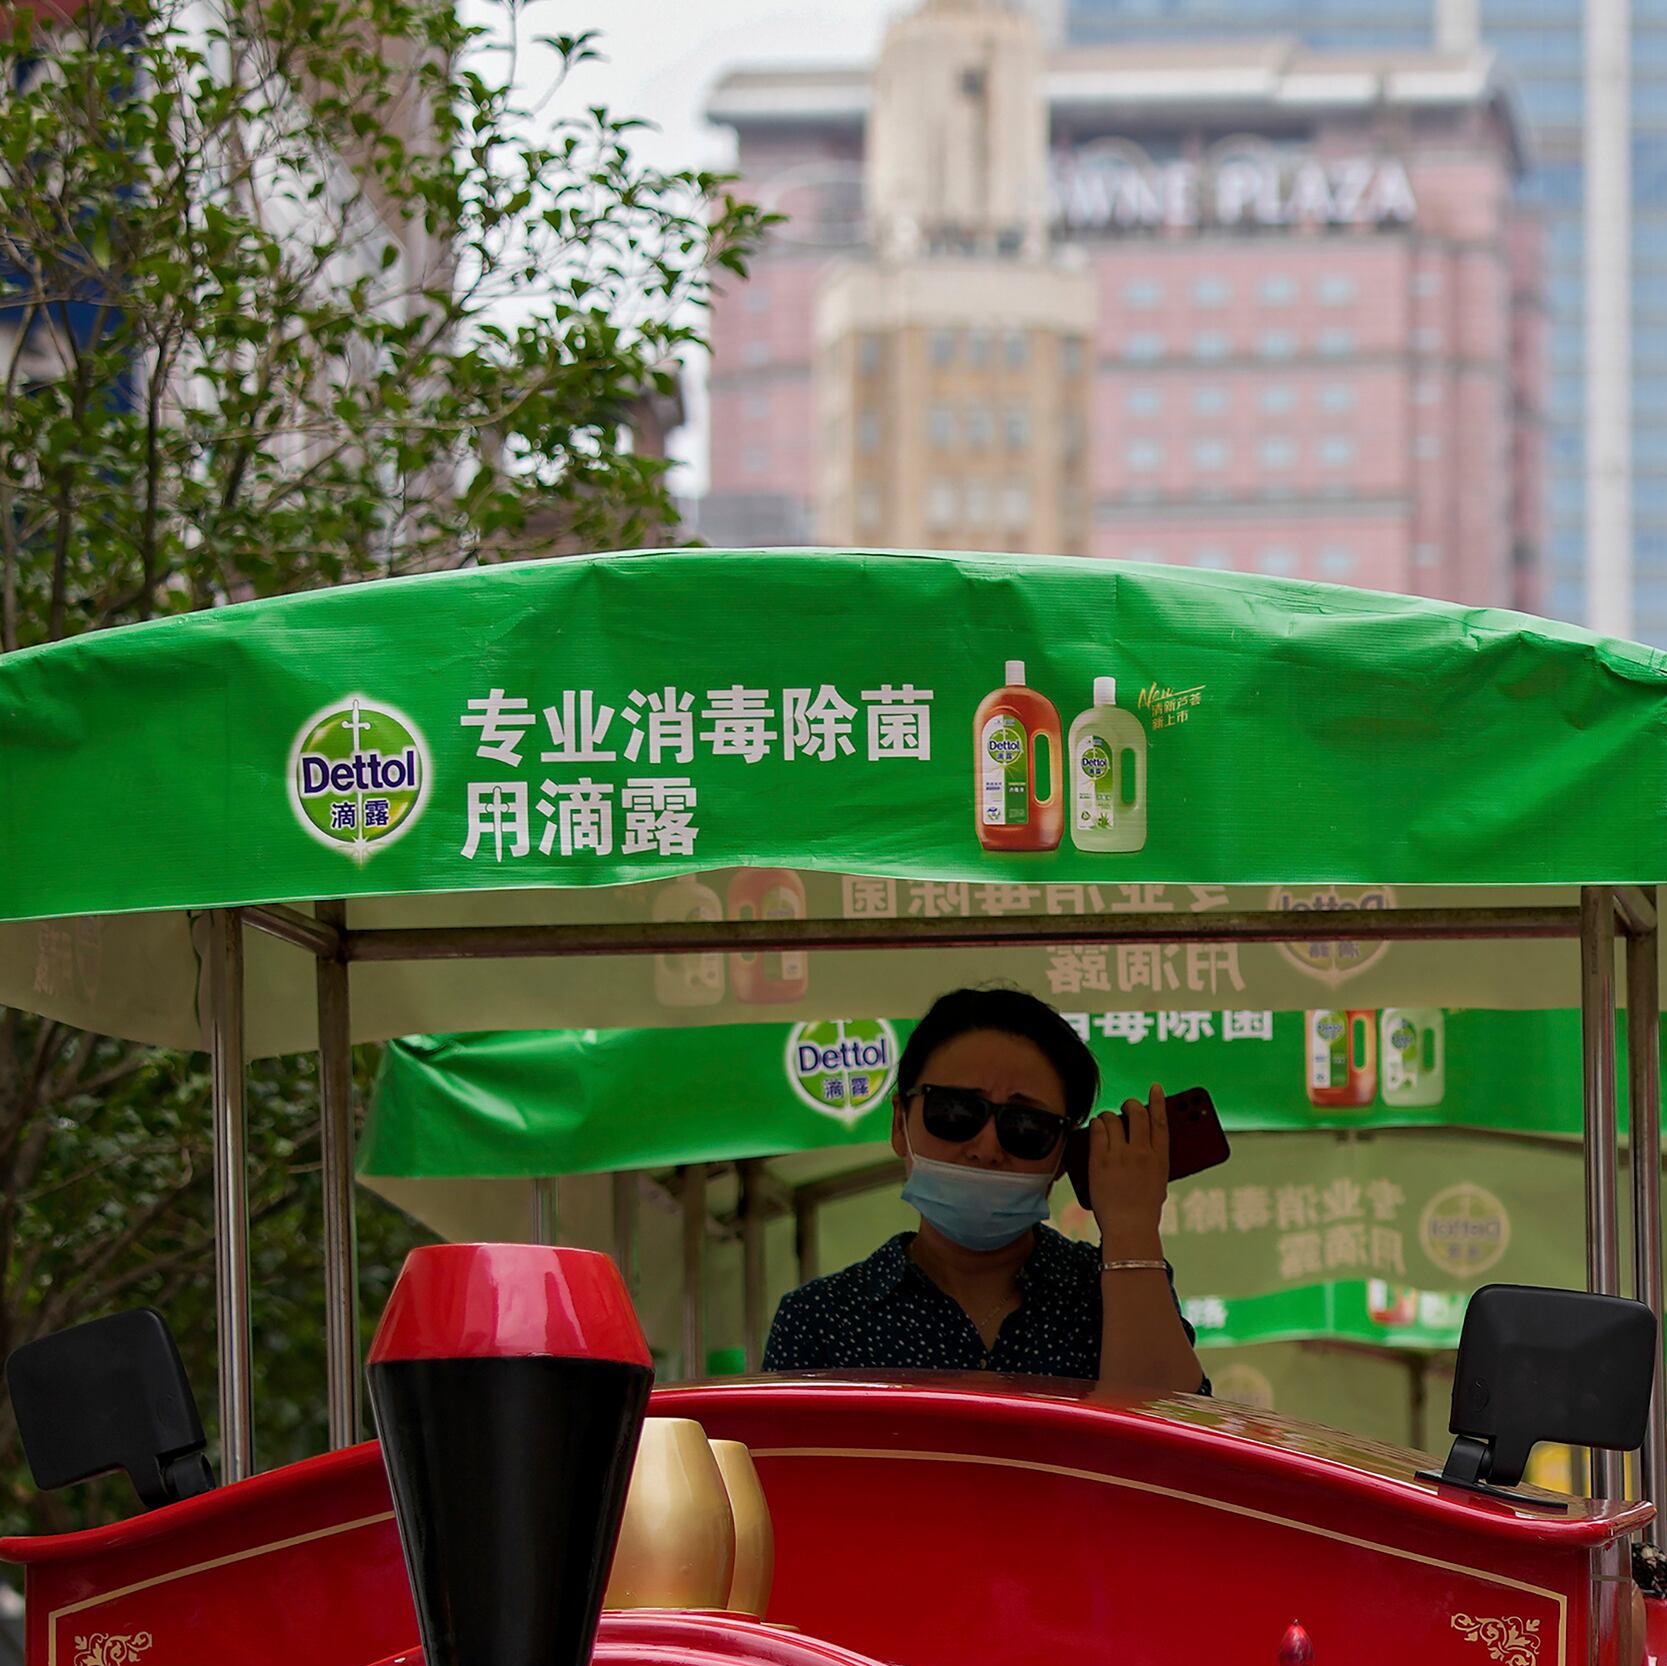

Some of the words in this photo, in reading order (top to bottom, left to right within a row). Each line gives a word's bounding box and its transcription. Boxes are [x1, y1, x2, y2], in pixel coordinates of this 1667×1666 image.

[1214, 160, 1418, 226] PLAZA
[460, 684, 935, 766] 专业消毒除菌
[1151, 710, 1189, 731] 新上市
[989, 739, 1021, 751] Dettol
[1081, 757, 1108, 769] Dettol
[300, 746, 417, 796] Dettol
[329, 798, 391, 830] 滴露
[460, 777, 699, 862] 用滴露
[797, 1034, 894, 1076] Dettol
[823, 1074, 872, 1102] 滴露
